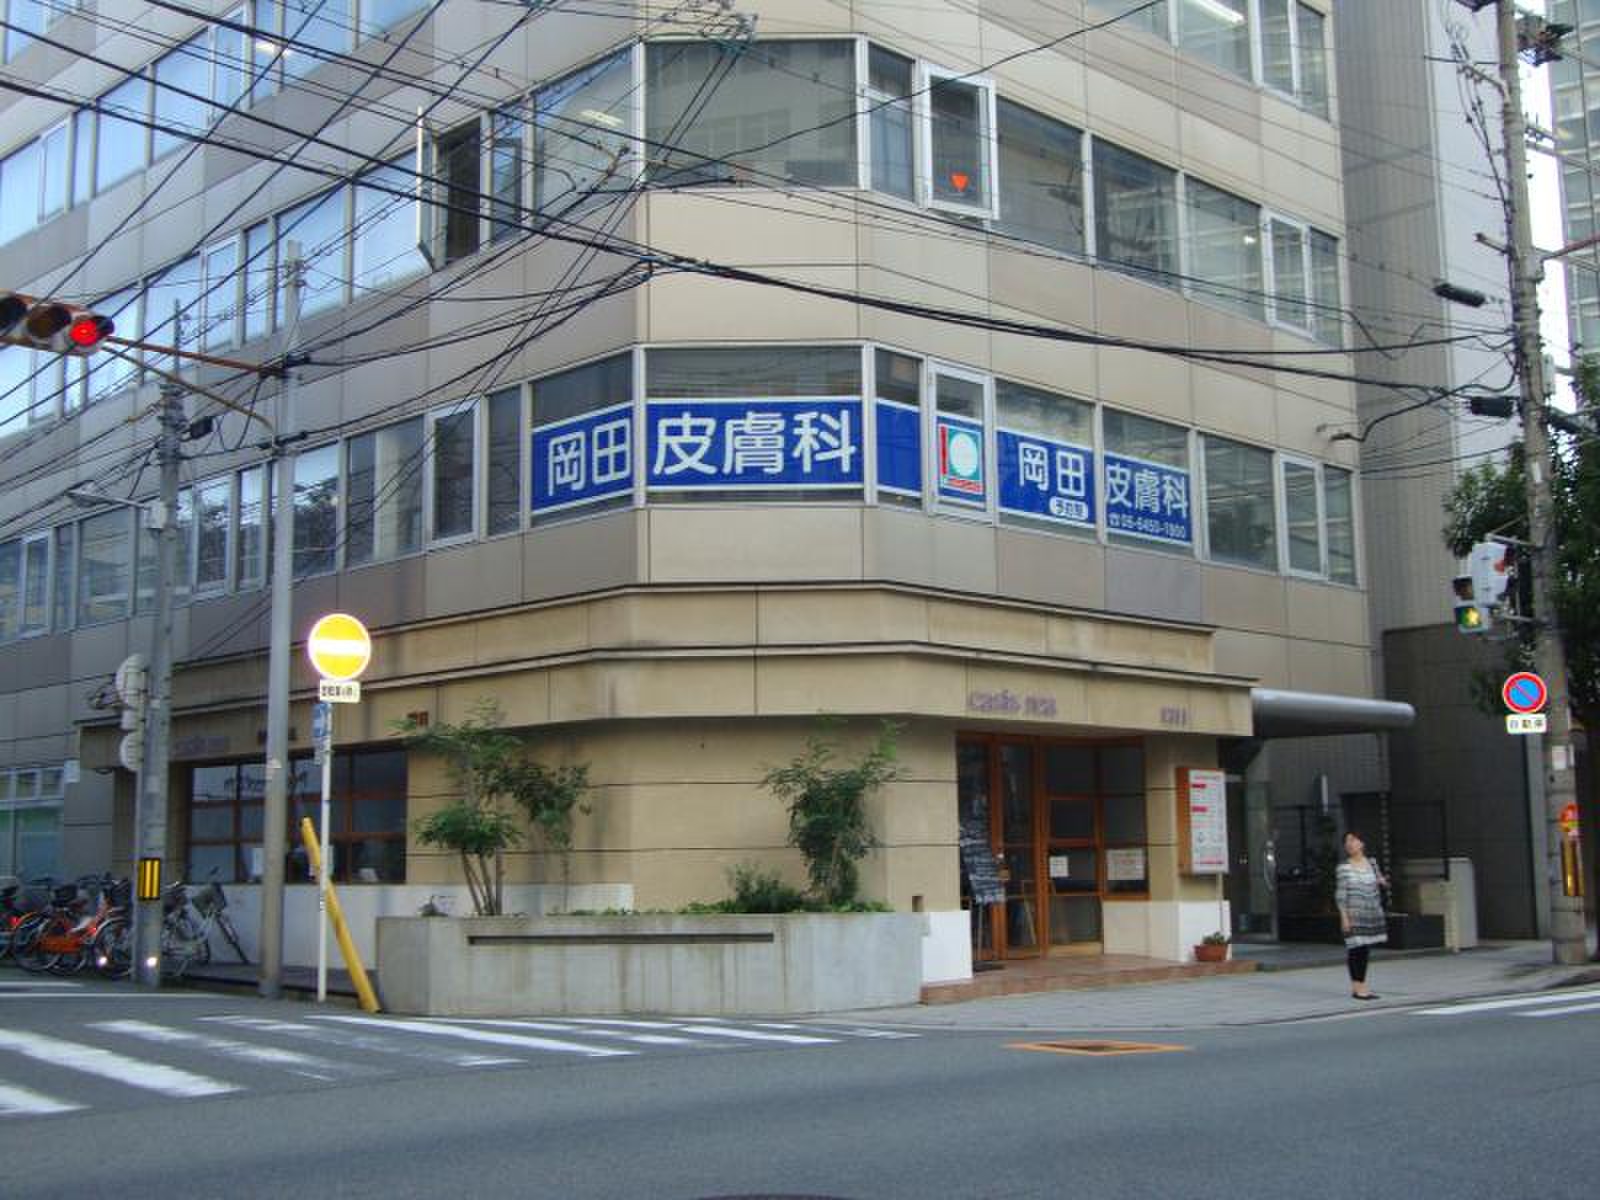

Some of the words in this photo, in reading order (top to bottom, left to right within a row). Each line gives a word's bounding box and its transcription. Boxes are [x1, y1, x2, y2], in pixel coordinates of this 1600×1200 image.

[549, 418, 631, 496] 岡田
[653, 409, 856, 475] 皮膚科
[1018, 442, 1085, 497] 岡田
[1106, 463, 1188, 519] 皮膚科
